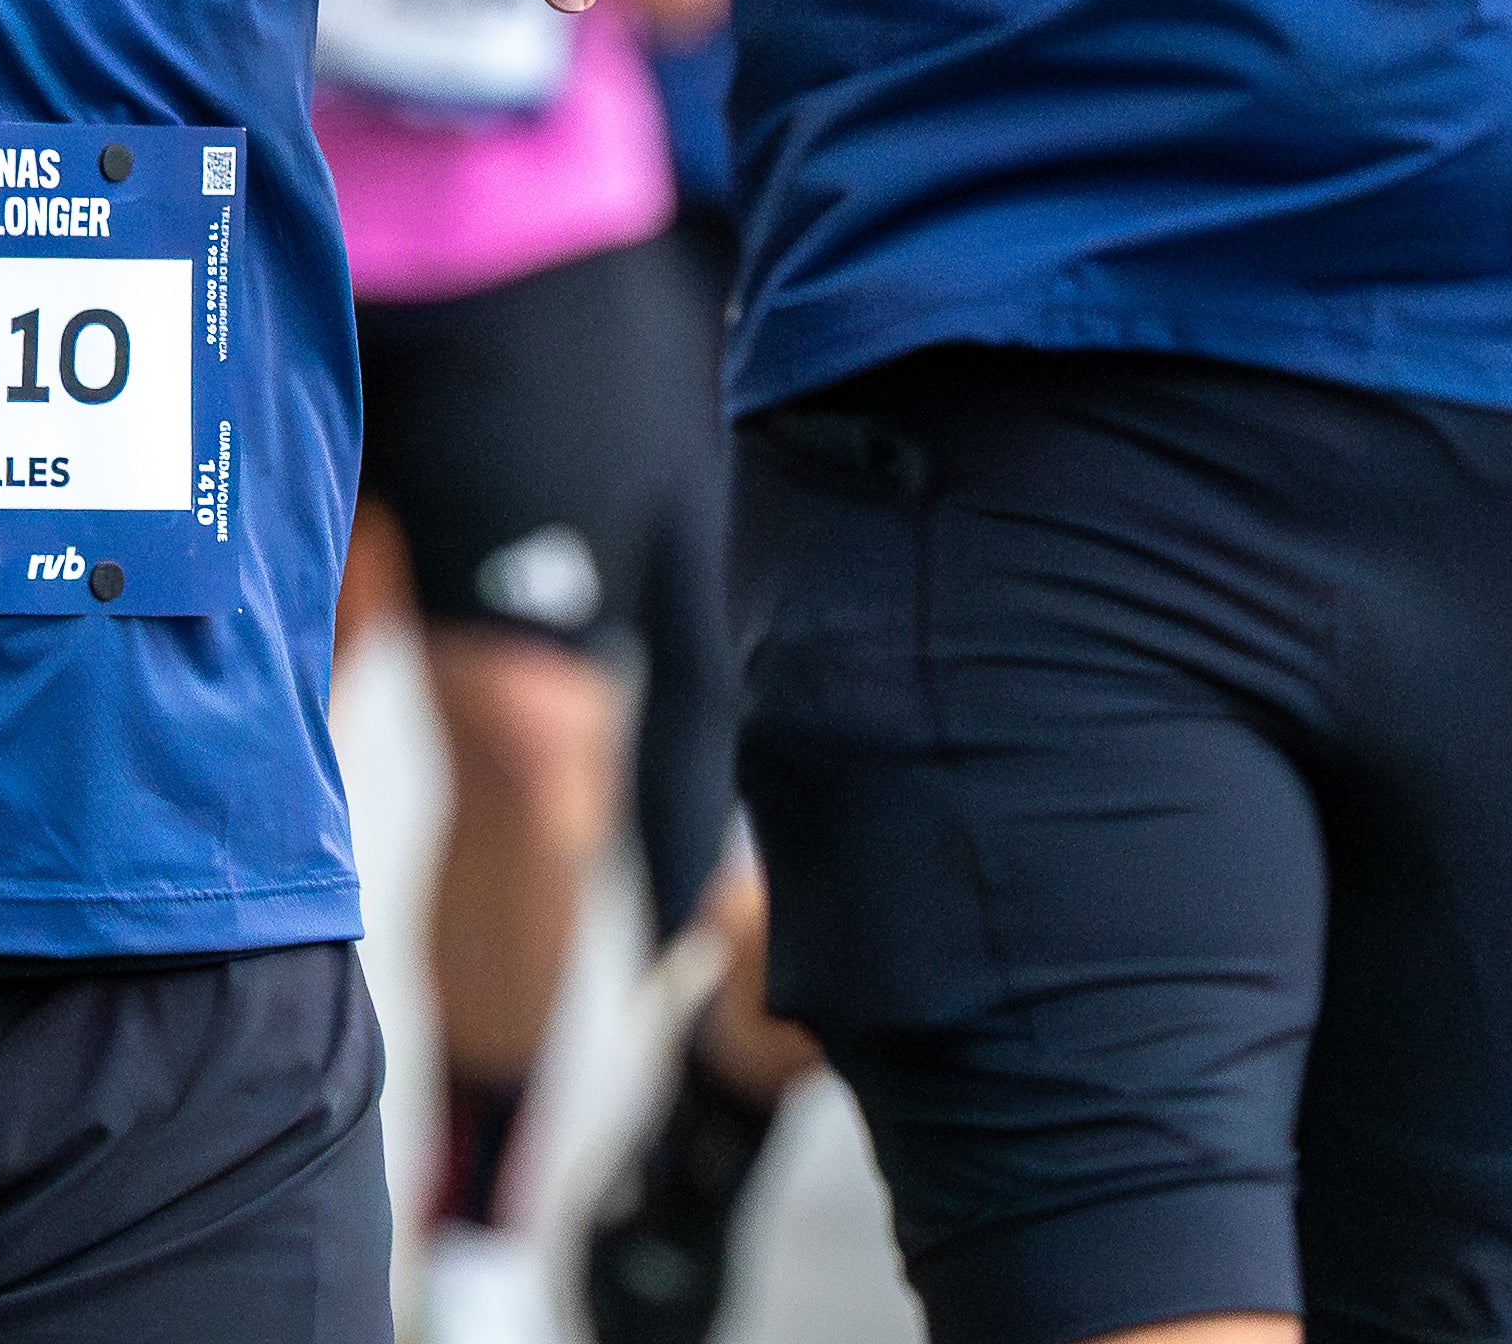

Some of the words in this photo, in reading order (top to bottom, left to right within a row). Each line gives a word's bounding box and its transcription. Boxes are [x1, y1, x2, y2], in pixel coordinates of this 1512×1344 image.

[218, 205, 230, 264] TELEFONE
[218, 266, 227, 283] DE
[196, 459, 215, 526] 1410
[215, 420, 231, 543] GUARDA-VOLUME
[27, 547, 86, 581] rvb
